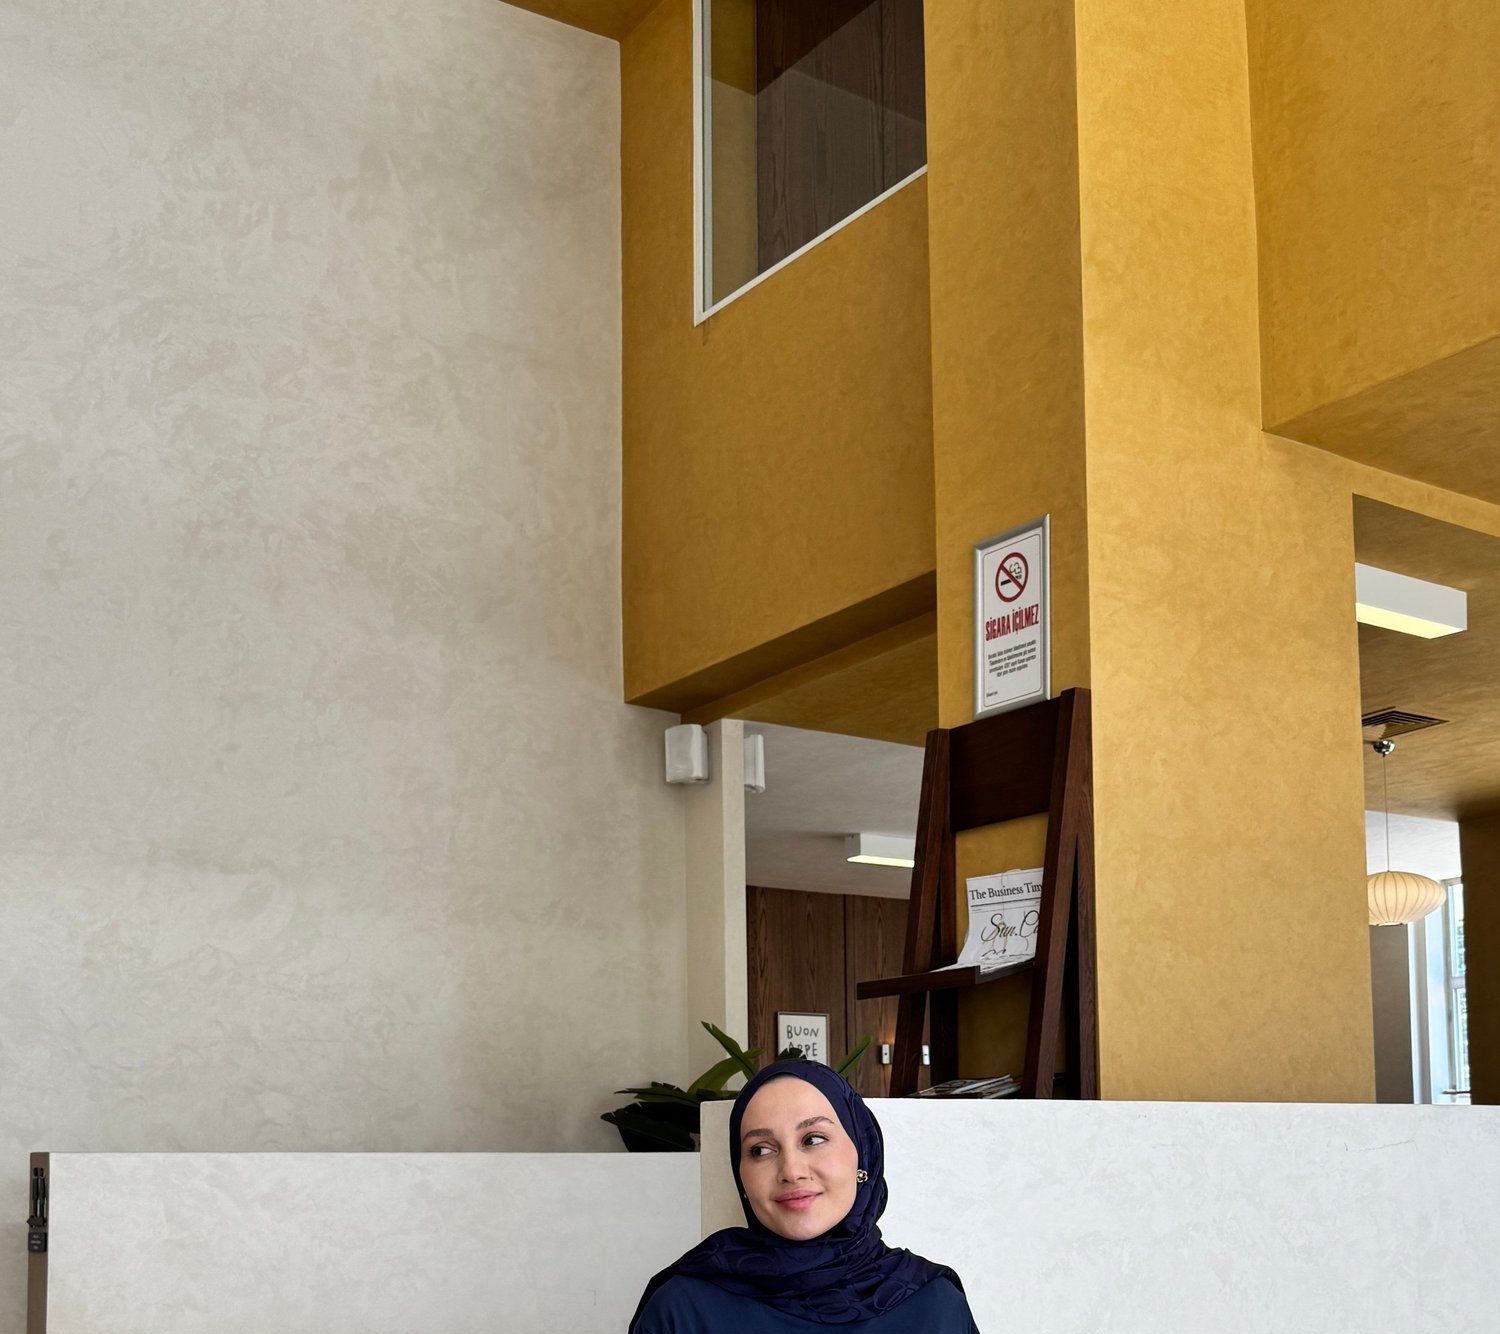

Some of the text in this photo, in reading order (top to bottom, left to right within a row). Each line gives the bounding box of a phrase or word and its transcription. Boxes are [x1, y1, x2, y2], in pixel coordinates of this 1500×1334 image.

[986, 603, 1039, 641] SİGARA İÇİLMEZ
[969, 889, 987, 900] The
[988, 885, 1024, 898] Business
[787, 1025, 819, 1039] BUON
